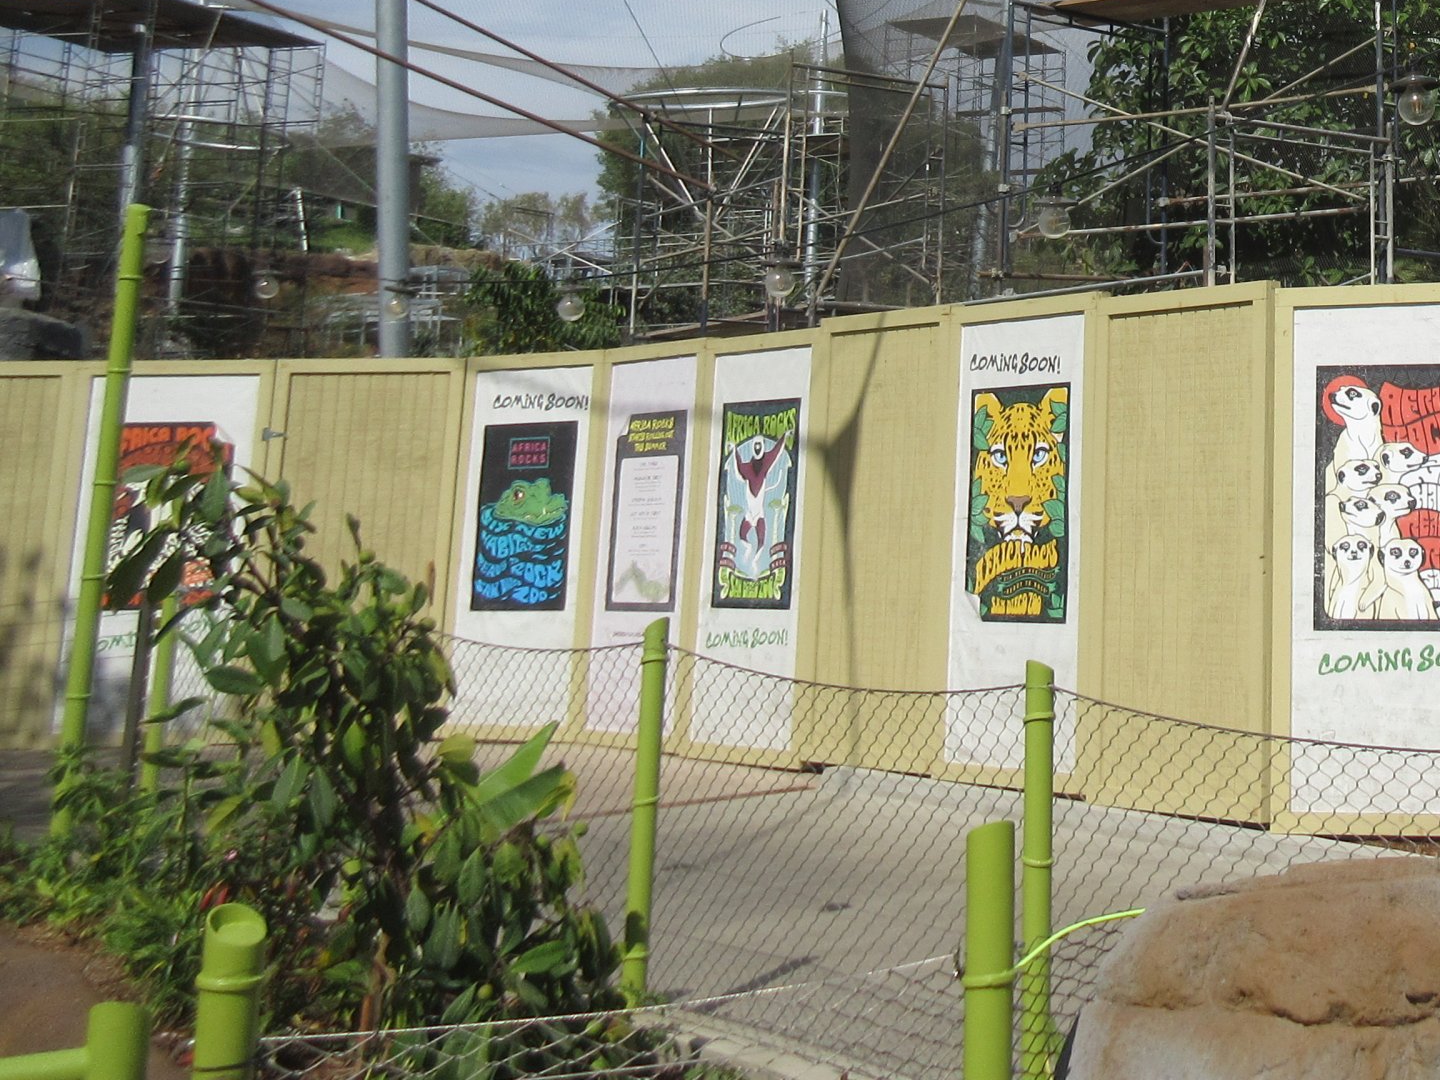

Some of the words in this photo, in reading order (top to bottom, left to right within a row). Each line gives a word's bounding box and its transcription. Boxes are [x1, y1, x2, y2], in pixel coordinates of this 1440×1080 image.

[1019, 352, 1061, 374] SOON!
[545, 393, 589, 411] SOON!
[121, 427, 171, 456] FRICA
[725, 411, 760, 456] AFRICA
[763, 407, 796, 450] ROCKS
[511, 441, 548, 453] AFRICA
[511, 453, 547, 466] ROCKS
[516, 522, 565, 540] NEW
[974, 540, 1023, 595] AFRICA
[1024, 539, 1058, 569] ROCKS
